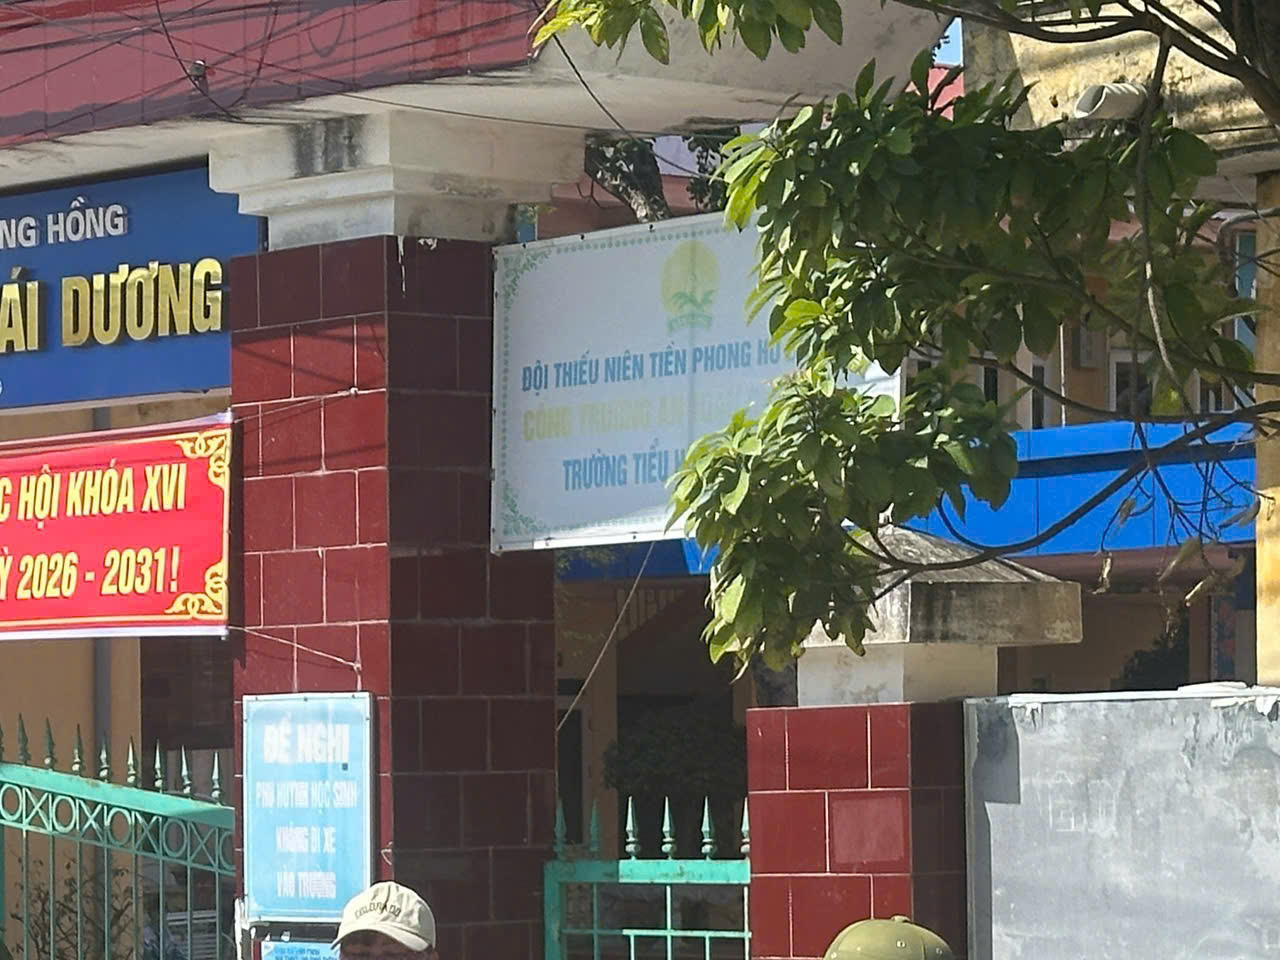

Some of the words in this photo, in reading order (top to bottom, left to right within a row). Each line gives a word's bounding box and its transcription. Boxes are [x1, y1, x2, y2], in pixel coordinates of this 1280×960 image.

[47, 196, 126, 243] HỒNG
[62, 258, 222, 347] DƯƠNG
[522, 360, 548, 396] ĐỘI
[553, 350, 599, 388] THIẾU
[604, 349, 644, 383] NIÊN
[649, 340, 687, 377] TIỀN
[692, 340, 751, 373] PHONG
[563, 448, 627, 491] TRƯỜNG
[632, 437, 668, 484] TIỂU
[18, 464, 59, 529] HỘI
[66, 459, 134, 515] KHÓA
[141, 463, 187, 512] XVI
[16, 551, 78, 599] 2026
[84, 571, 95, 581] -
